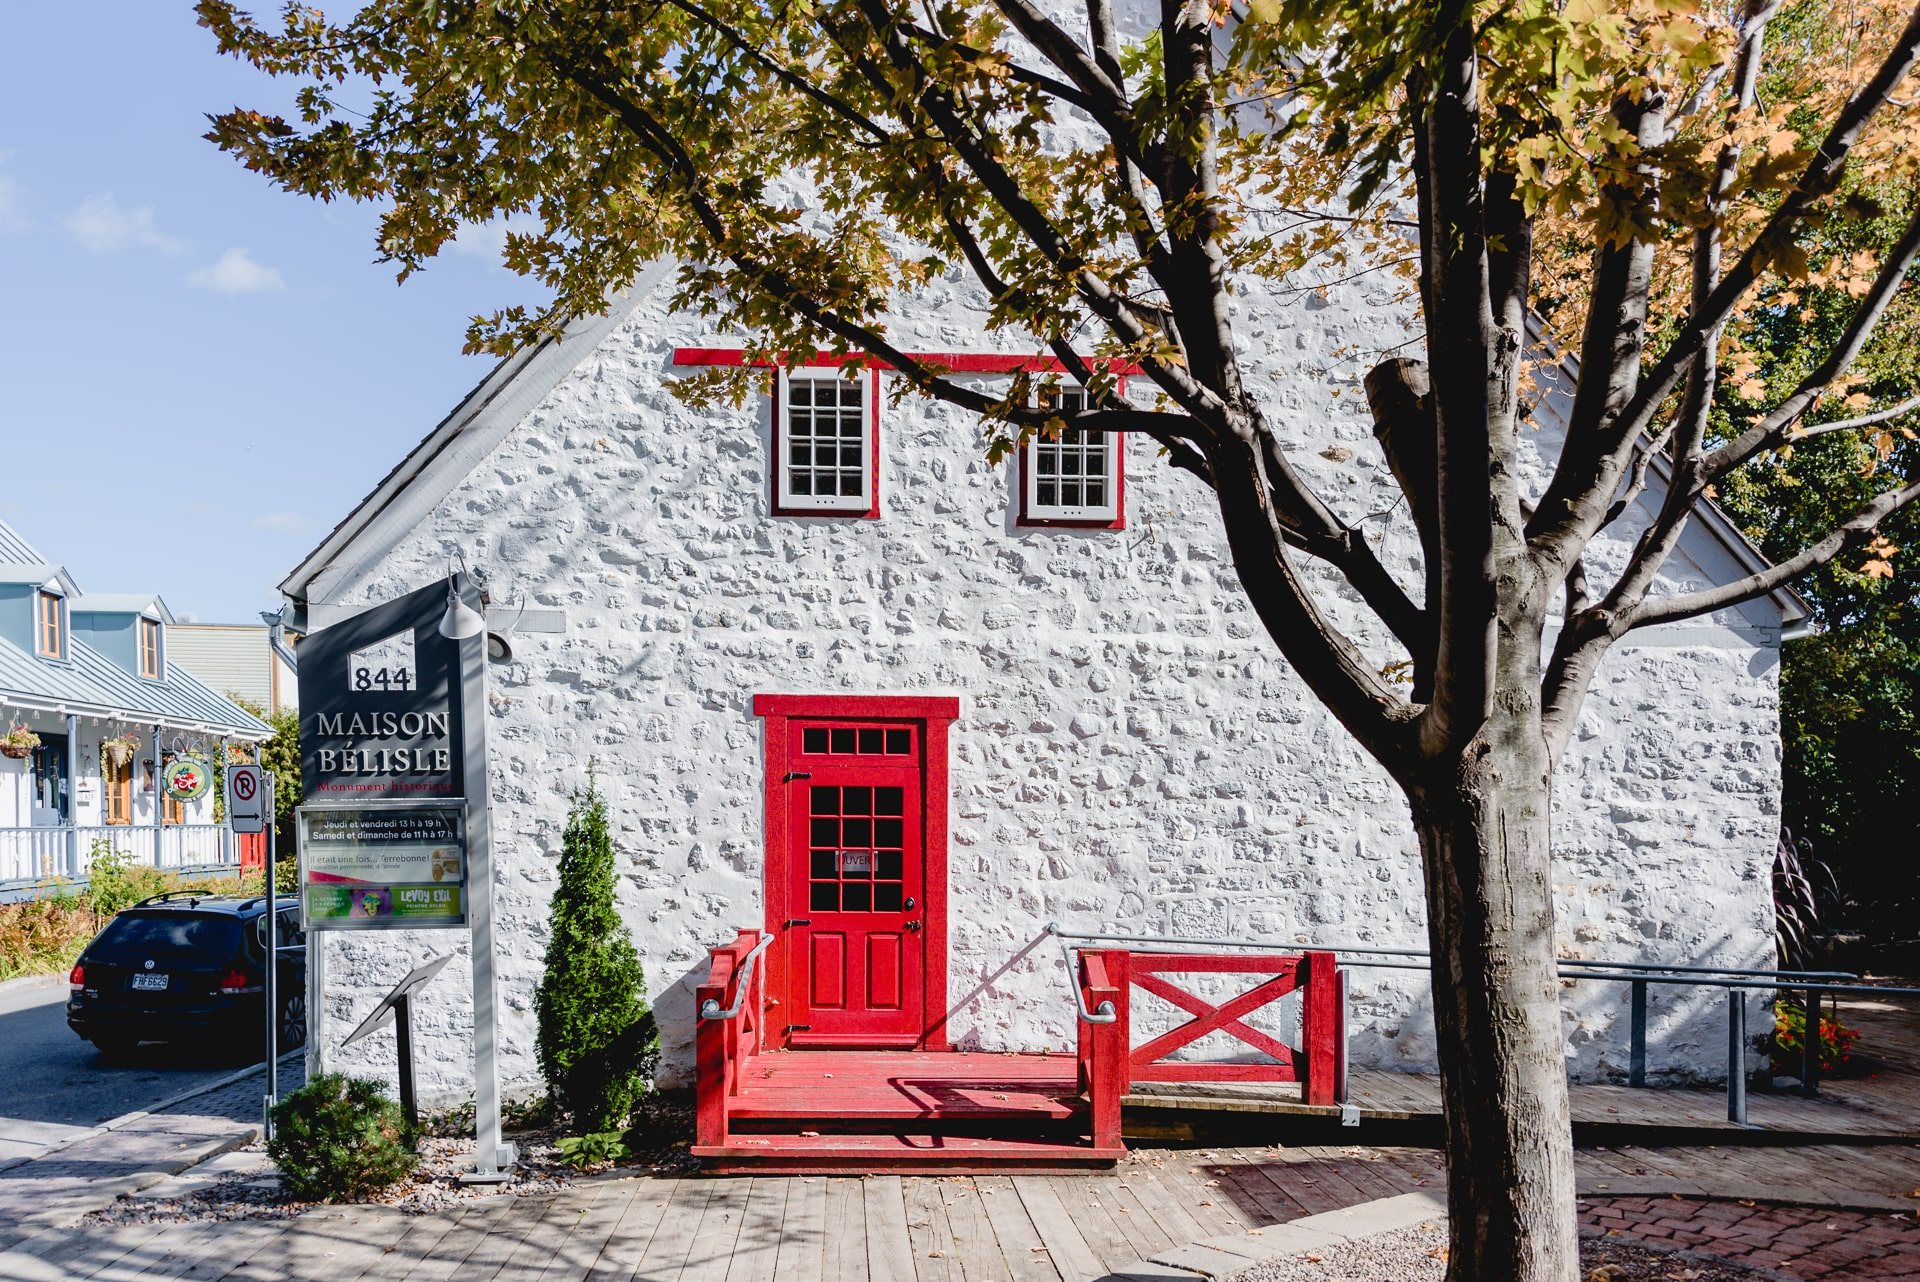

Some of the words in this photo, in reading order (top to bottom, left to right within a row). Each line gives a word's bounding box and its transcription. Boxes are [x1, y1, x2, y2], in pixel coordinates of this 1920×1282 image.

[355, 667, 411, 691] 844
[316, 711, 450, 736] MAISON
[318, 741, 451, 772] BÉLISLE
[316, 782, 386, 792] Monument
[391, 780, 454, 793] historique
[324, 820, 348, 829] Jeudi
[349, 820, 358, 828] et
[360, 820, 397, 828] vendredi
[399, 820, 408, 828] 13
[410, 820, 416, 828] h
[424, 820, 434, 828] 19
[436, 819, 441, 827] h
[312, 831, 345, 840] Samedi
[346, 832, 356, 840] et
[358, 830, 399, 840] dimanche
[400, 830, 412, 838] de
[437, 830, 446, 838] 17
[448, 830, 453, 838] h
[317, 855, 336, 864] était
[838, 855, 877, 865] OUVER
